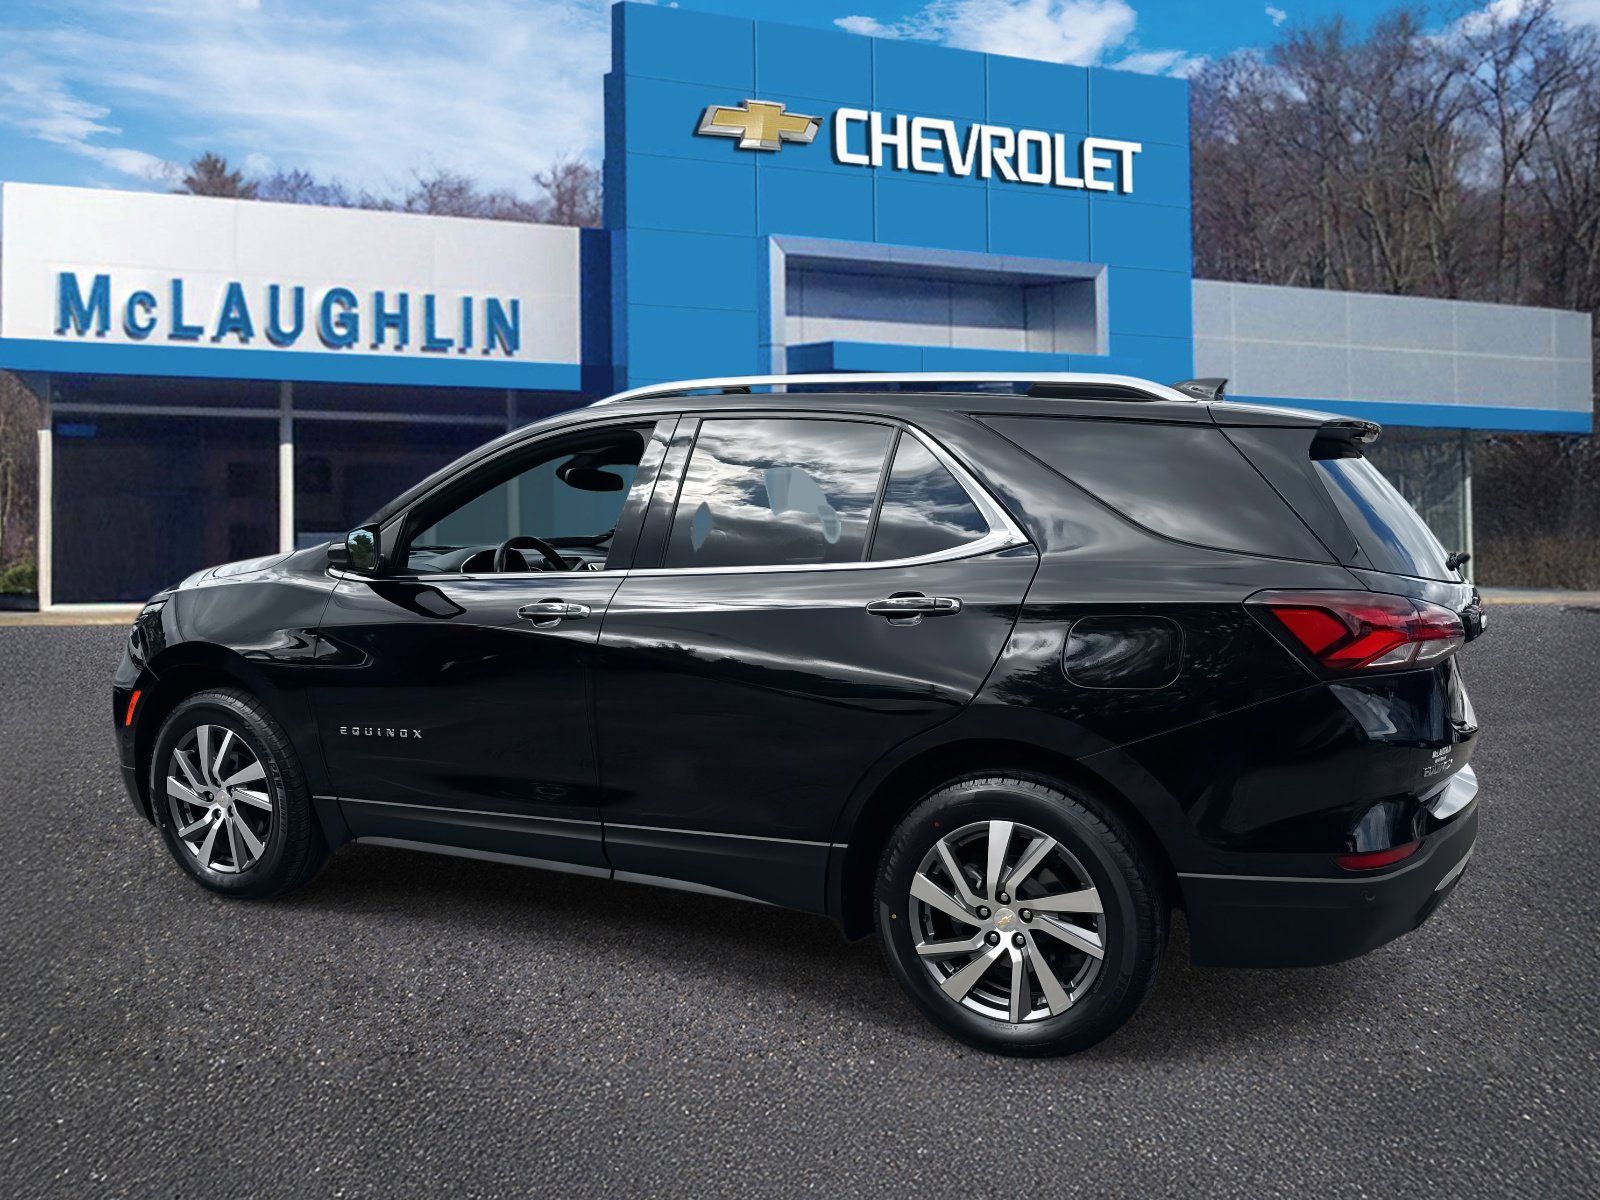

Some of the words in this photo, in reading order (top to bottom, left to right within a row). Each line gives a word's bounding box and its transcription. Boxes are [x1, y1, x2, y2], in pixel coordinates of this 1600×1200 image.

[834, 107, 1142, 194] CHEVROLET
[55, 271, 520, 356] McLAUGHLIN
[339, 726, 422, 739] EQUINOX
